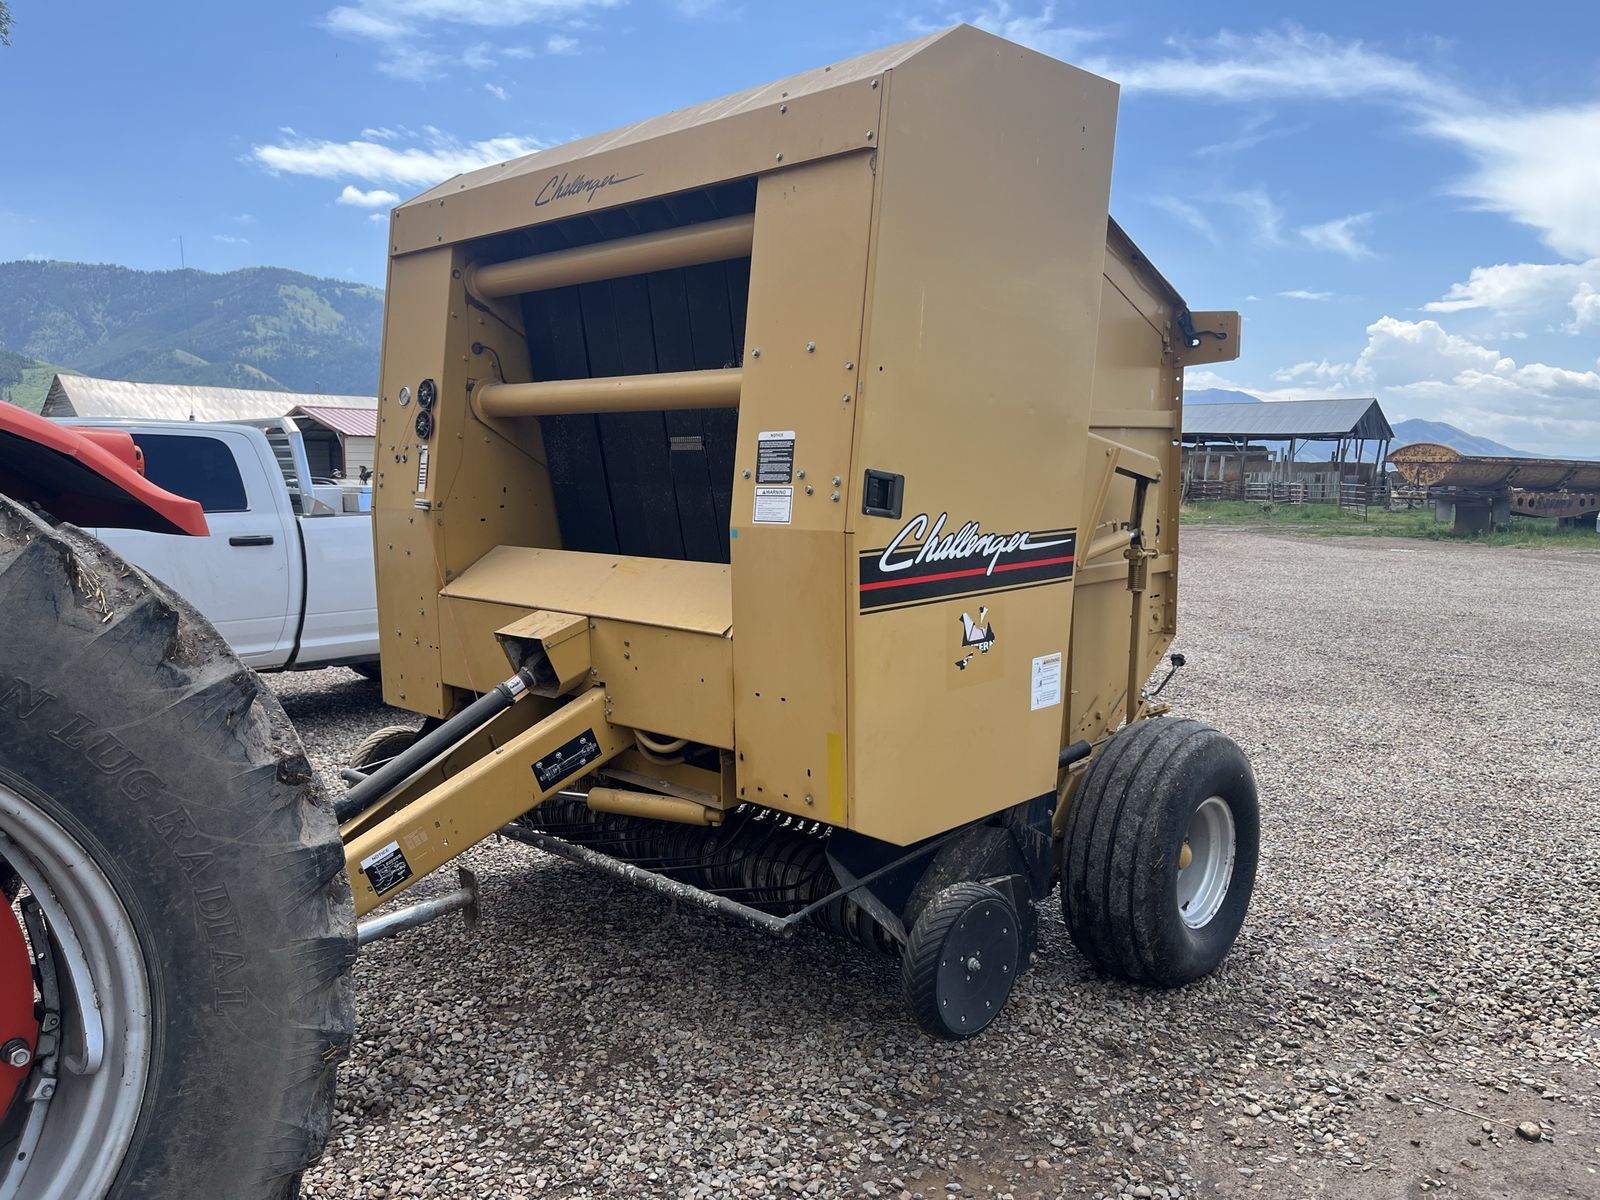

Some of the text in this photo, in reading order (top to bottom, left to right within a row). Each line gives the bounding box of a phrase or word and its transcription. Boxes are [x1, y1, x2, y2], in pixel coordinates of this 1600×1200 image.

[535, 172, 644, 207] Challenger
[879, 511, 1072, 576] Challenger
[48, 711, 168, 801] LUG
[151, 804, 250, 1017] RADIAL
[371, 848, 389, 861] NOTICE
